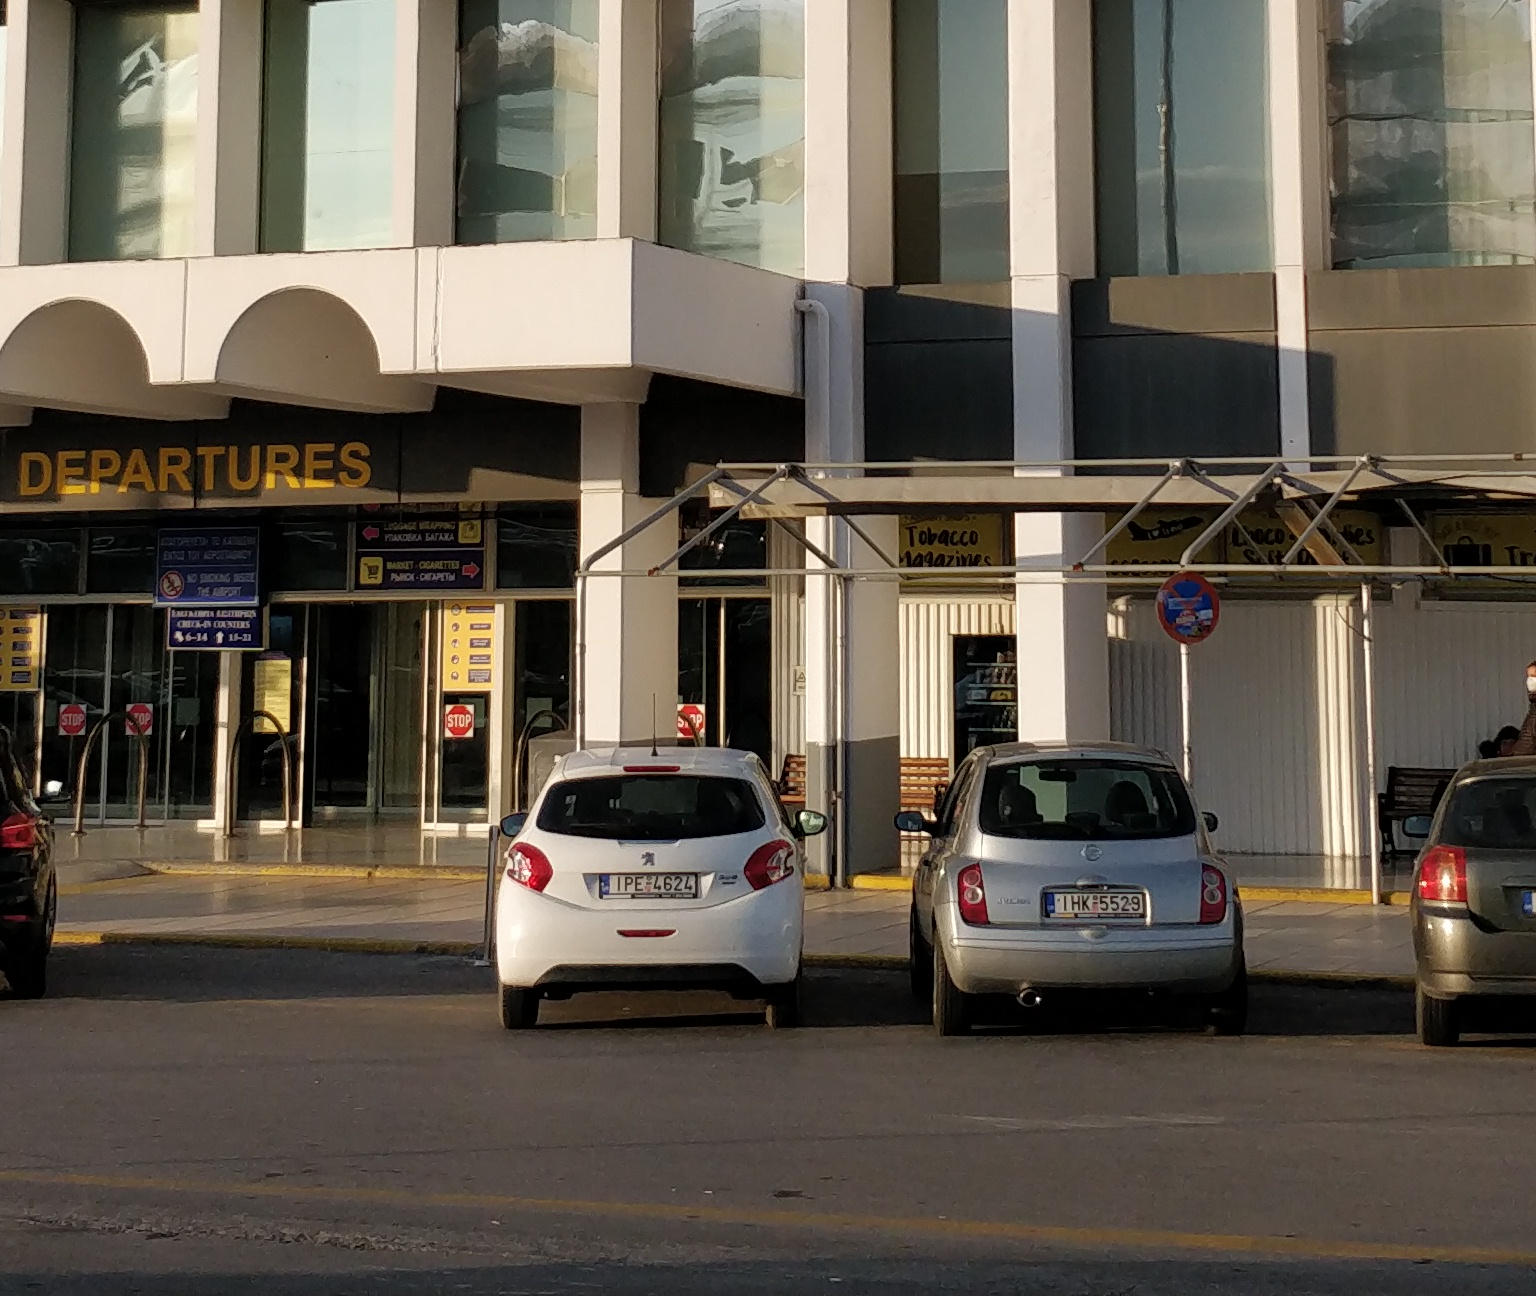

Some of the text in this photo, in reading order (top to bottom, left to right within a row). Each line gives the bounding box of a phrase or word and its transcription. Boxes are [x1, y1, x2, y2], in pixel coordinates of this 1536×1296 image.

[18, 441, 372, 497] DEPARTURES
[904, 526, 978, 547] Tobacco
[61, 713, 85, 726] STOP
[447, 713, 472, 728] STOP
